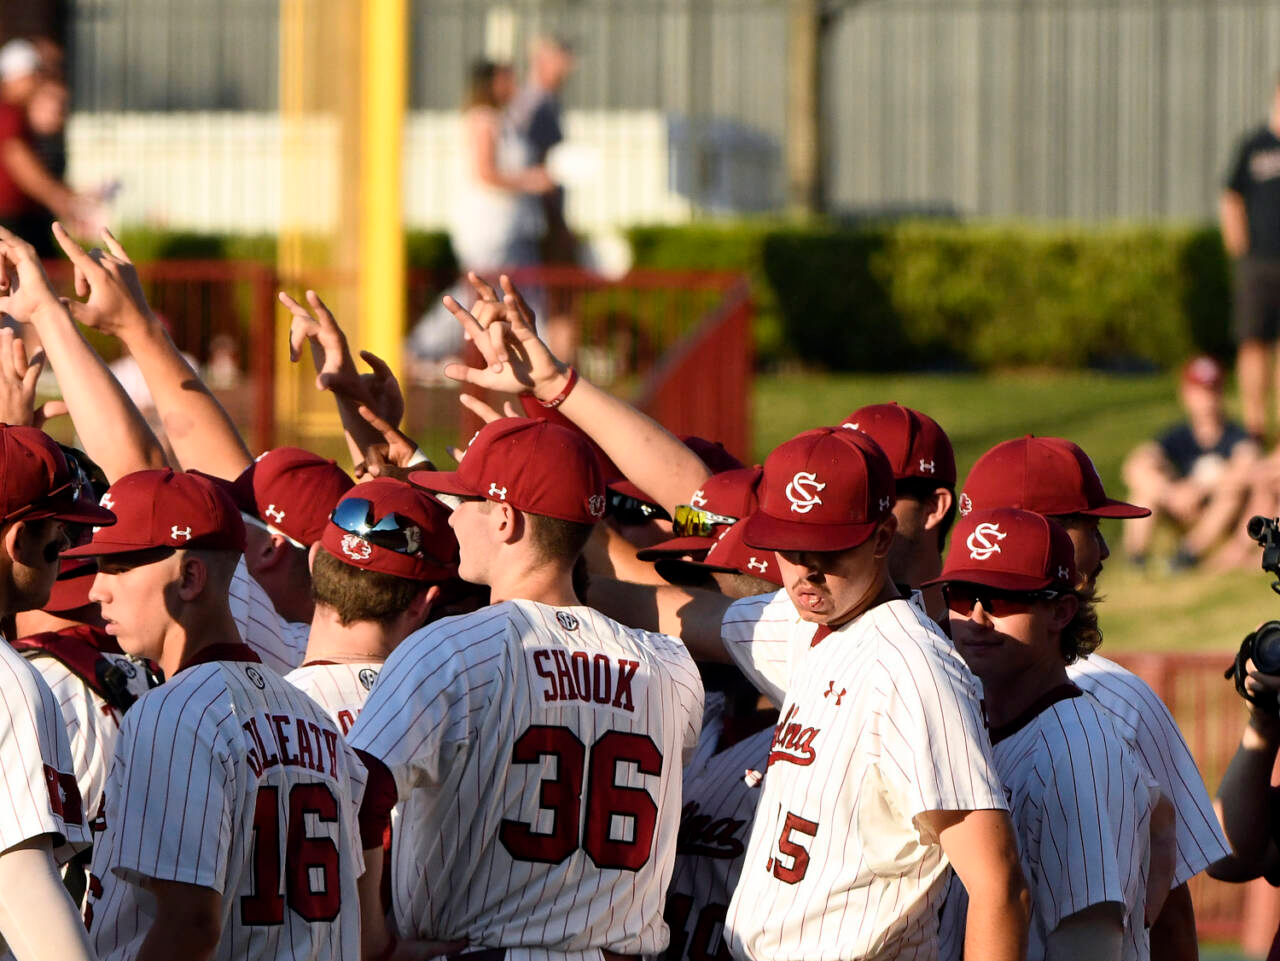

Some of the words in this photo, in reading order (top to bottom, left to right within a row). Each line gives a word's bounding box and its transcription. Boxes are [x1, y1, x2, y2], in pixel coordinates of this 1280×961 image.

[785, 471, 826, 514] SC
[966, 522, 1008, 560] SC
[533, 649, 640, 713] SHOOK
[498, 724, 663, 873] 36
[240, 782, 342, 926] 16
